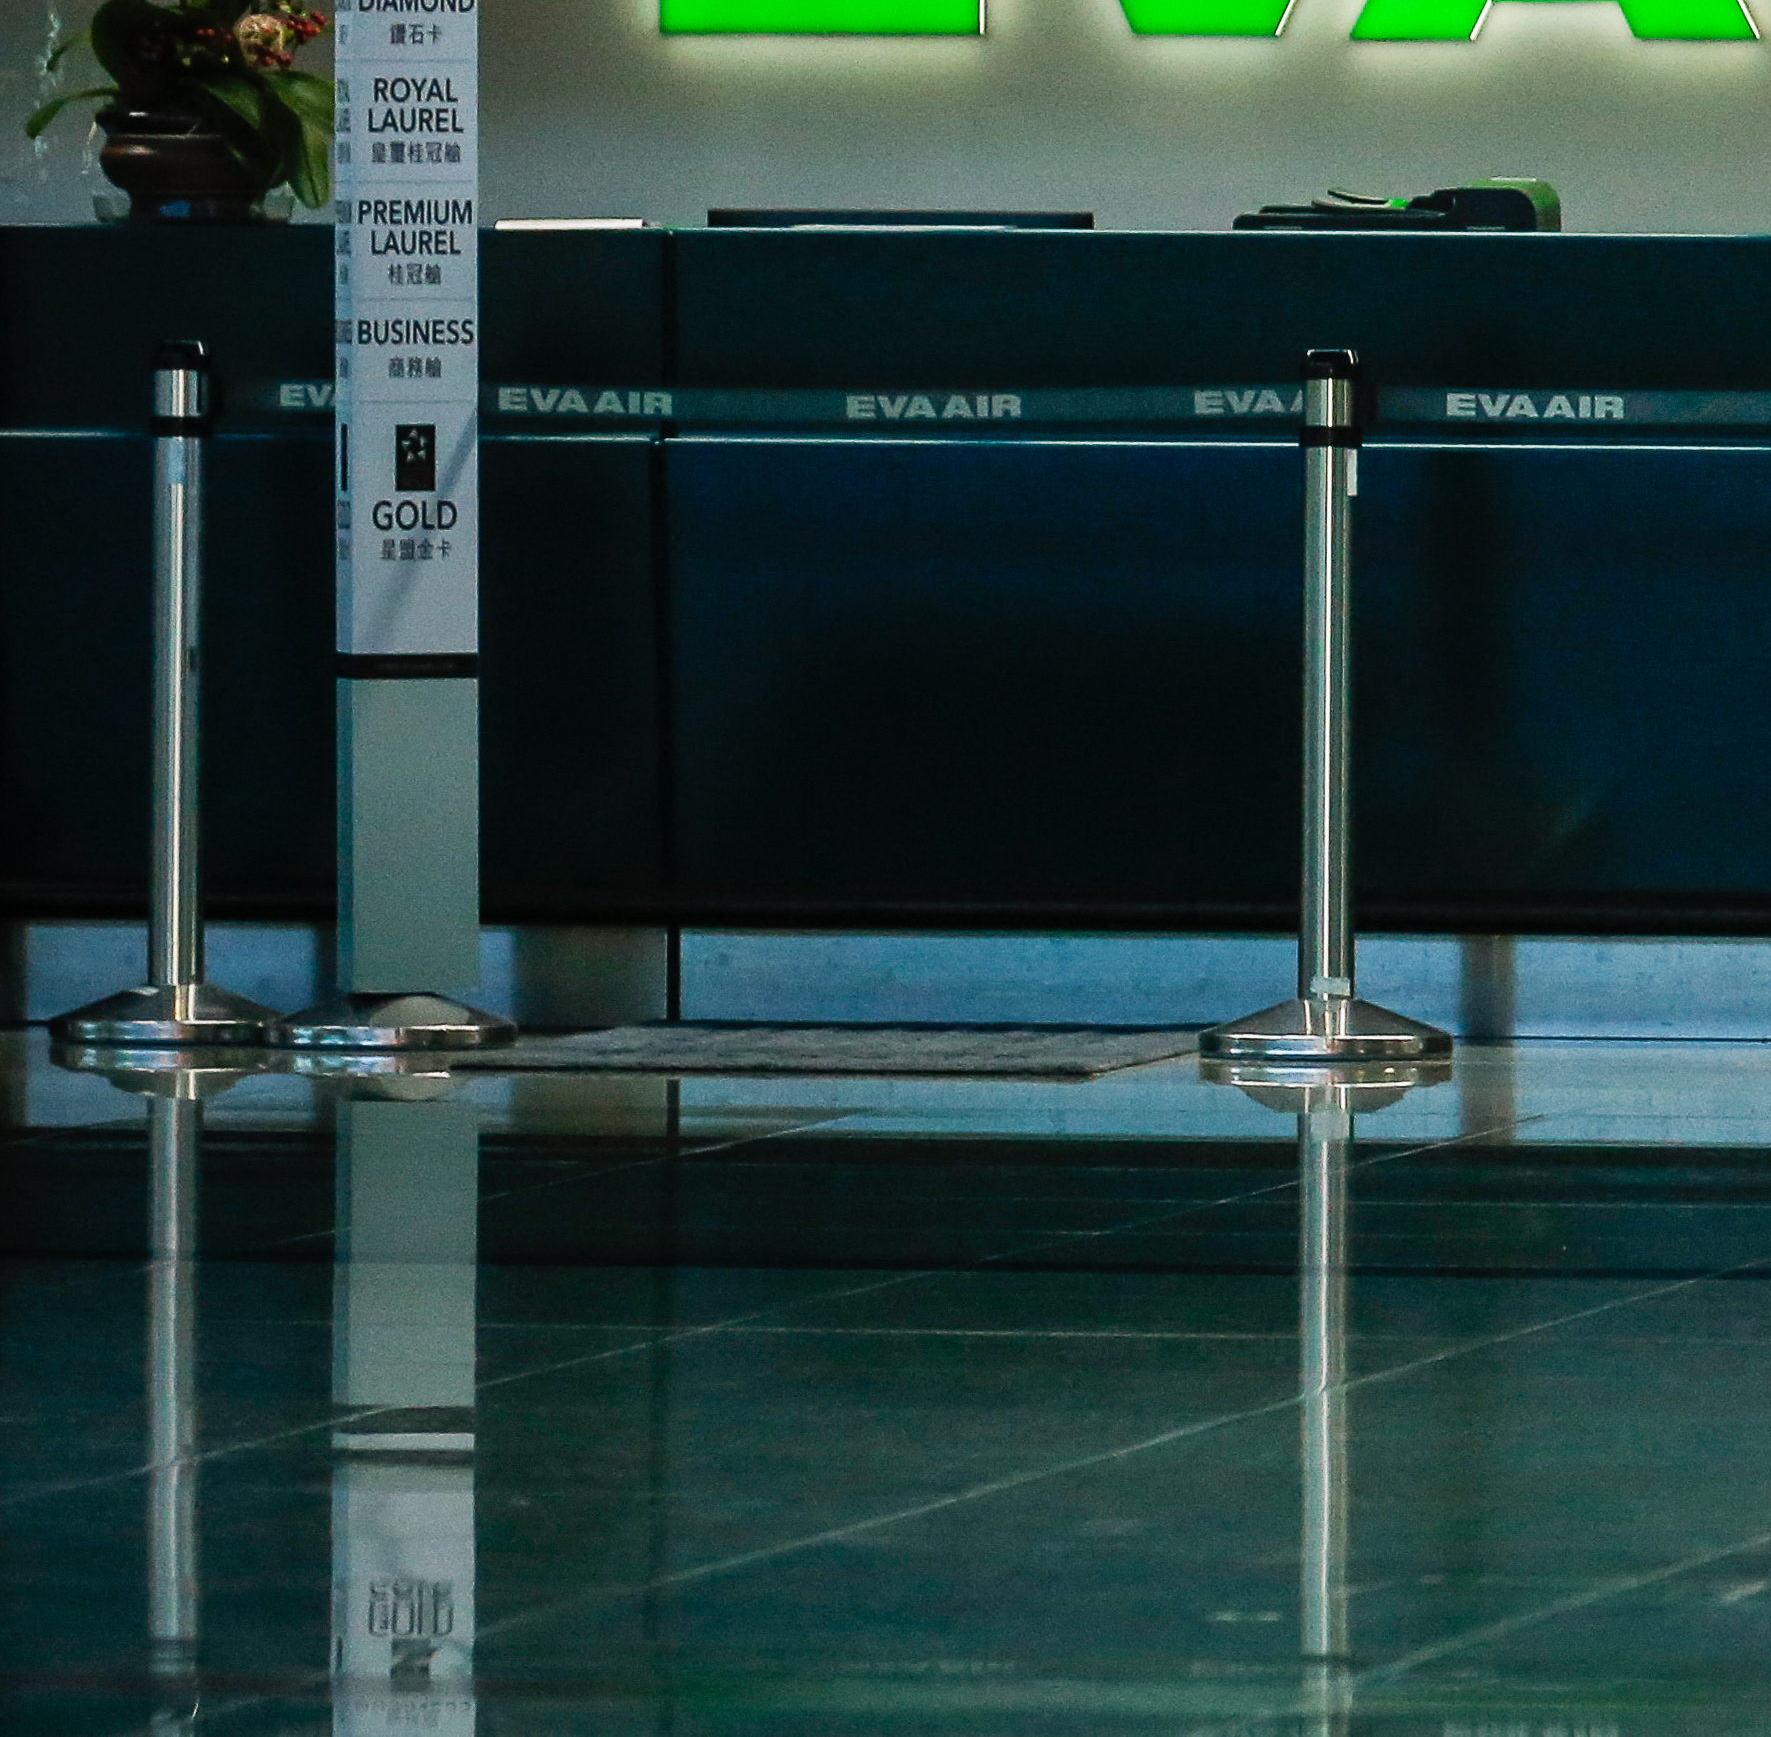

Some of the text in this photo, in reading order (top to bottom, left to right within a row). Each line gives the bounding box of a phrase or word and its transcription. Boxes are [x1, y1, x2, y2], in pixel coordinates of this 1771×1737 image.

[374, 78, 458, 103] ROYAL
[368, 108, 464, 133] LAUREL
[357, 200, 472, 225] PREMIUM
[371, 230, 461, 255] LAUREL
[357, 319, 474, 345] BUSINESS
[372, 499, 458, 532] GOLD
